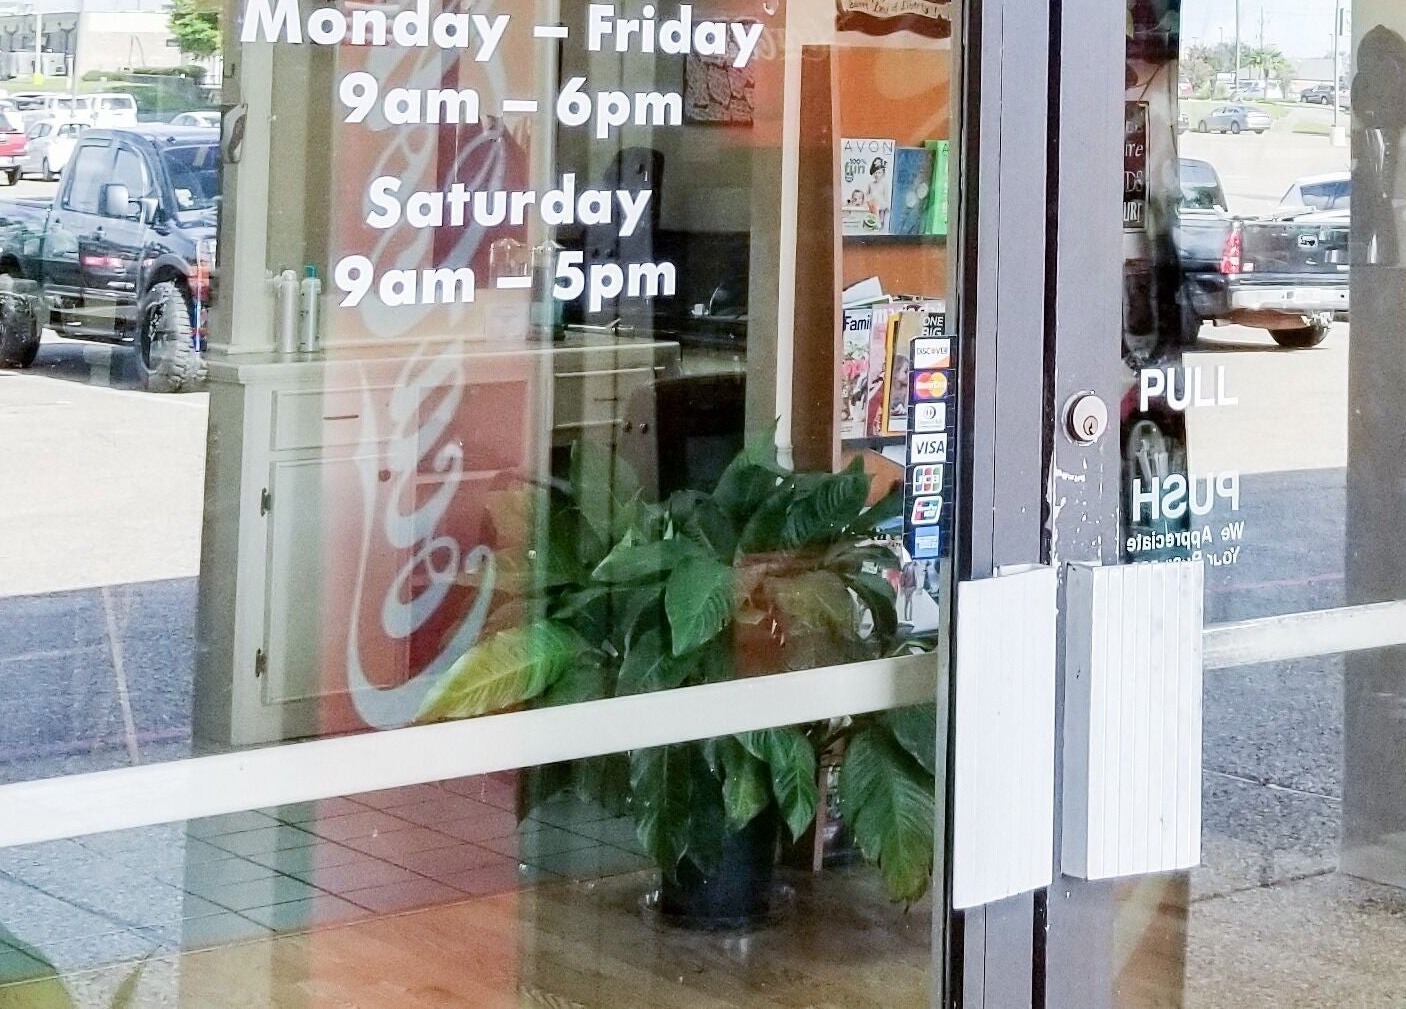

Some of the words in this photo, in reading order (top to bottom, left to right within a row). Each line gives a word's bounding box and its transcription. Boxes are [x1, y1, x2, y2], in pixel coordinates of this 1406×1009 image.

[588, 2, 764, 68] Friday
[338, 71, 480, 123] 9am
[556, 76, 683, 139] 6pm
[844, 140, 893, 153] AVON
[365, 172, 652, 237] Saturday
[334, 253, 475, 308] 9am
[551, 250, 676, 312] 5pm
[921, 327, 942, 336] BIG
[923, 316, 944, 327] ONE
[1139, 365, 1239, 413] PULL
[916, 440, 945, 455] VISA
